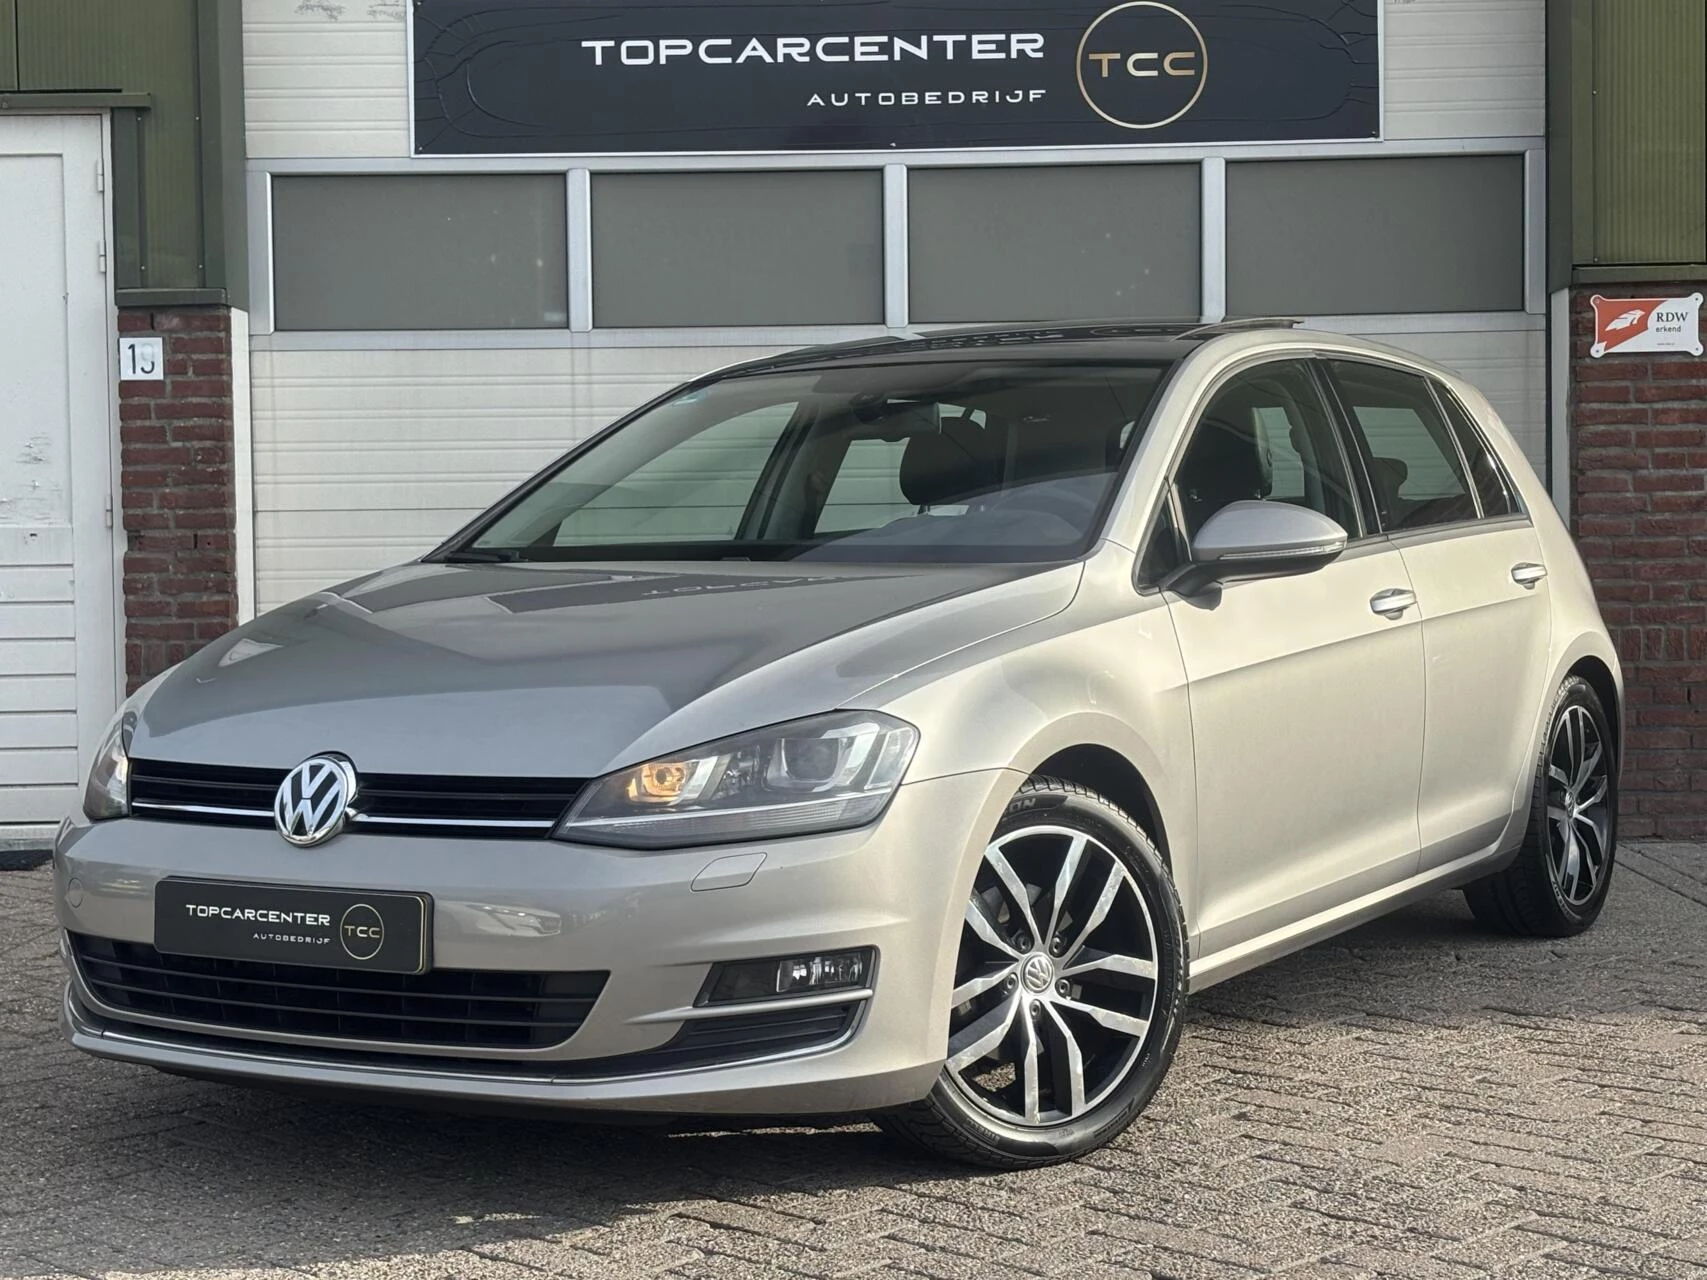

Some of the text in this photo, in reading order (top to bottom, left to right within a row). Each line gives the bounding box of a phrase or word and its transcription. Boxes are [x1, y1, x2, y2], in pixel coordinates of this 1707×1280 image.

[581, 32, 1045, 66] TOPCARCENTER
[1088, 51, 1196, 78] TCC
[806, 88, 1047, 107] AUTOBEDRIJF
[1656, 311, 1689, 323] RDW
[1655, 324, 1682, 333] erkend
[185, 904, 331, 927] TOPCARCENTER
[252, 932, 331, 945] AUTOBEDRIJF
[343, 924, 381, 939] TCC
